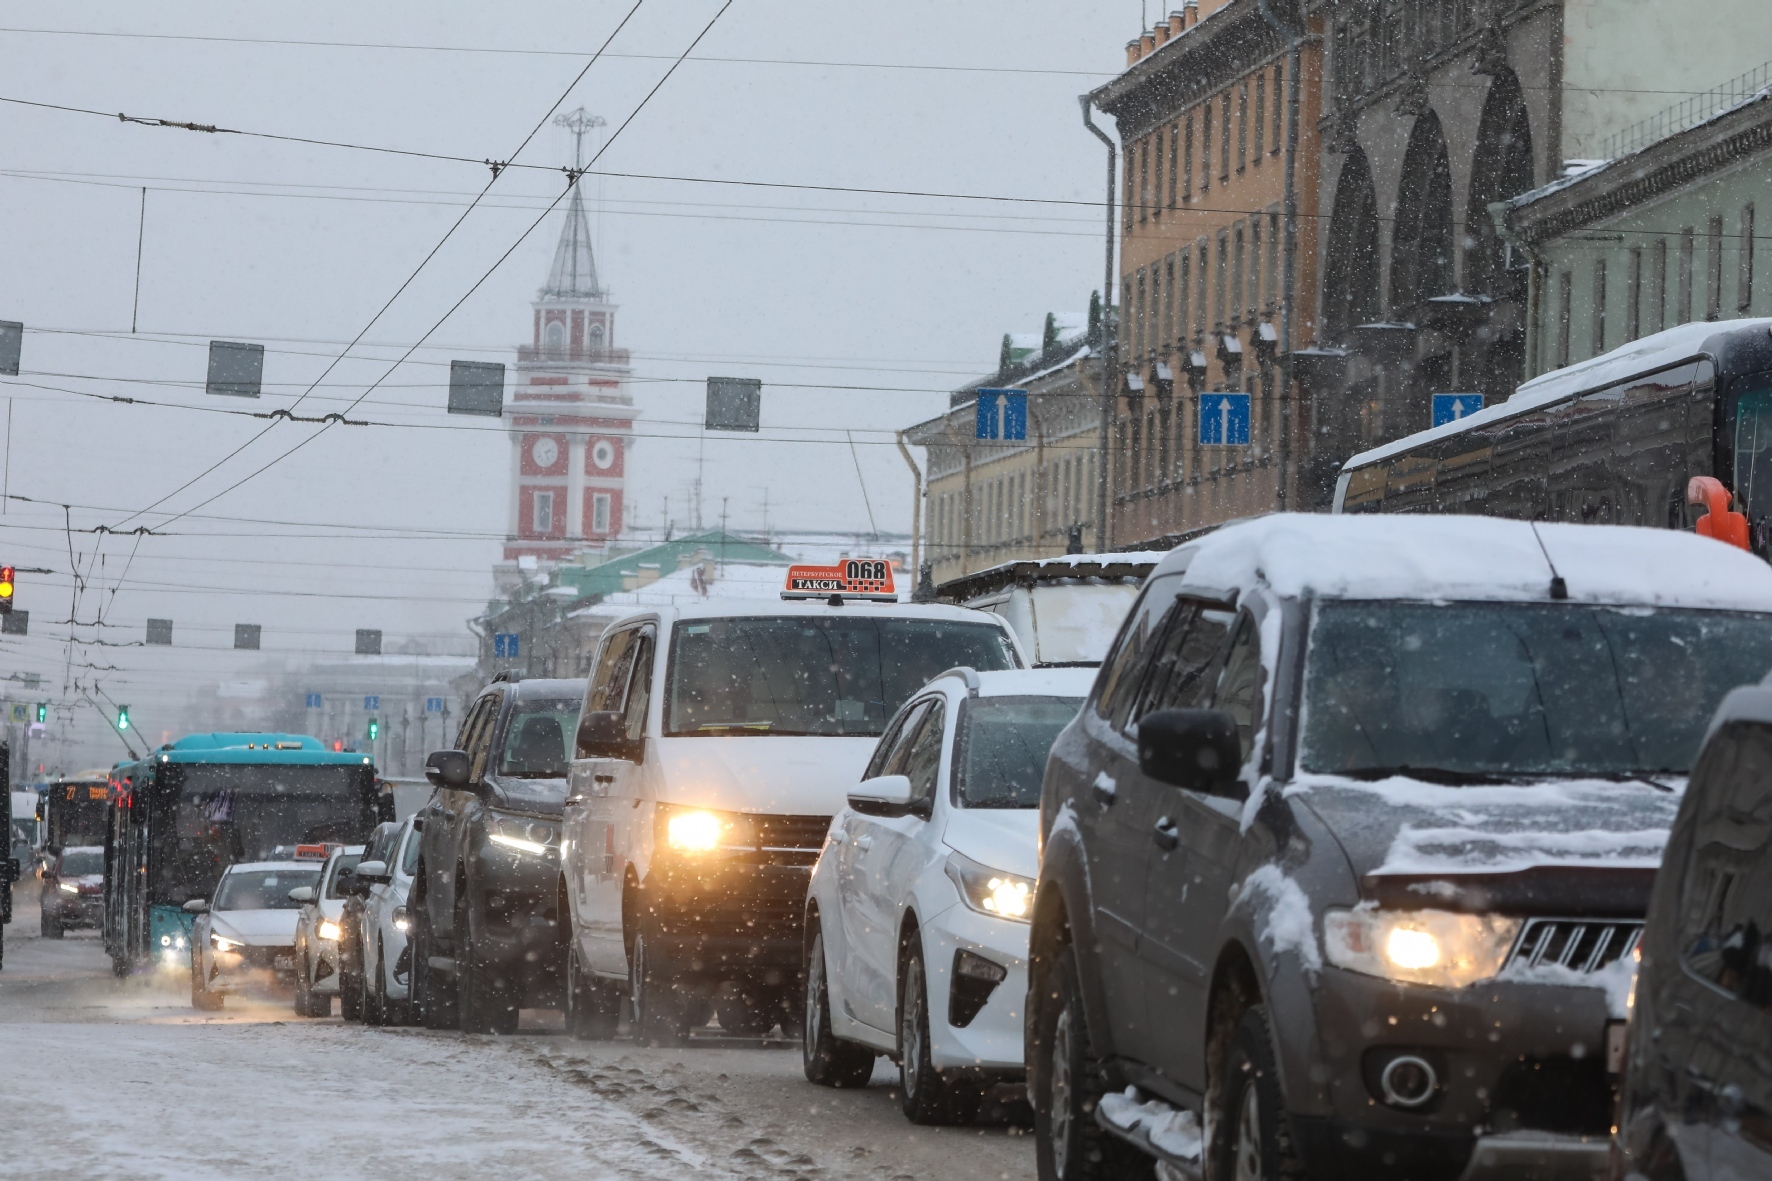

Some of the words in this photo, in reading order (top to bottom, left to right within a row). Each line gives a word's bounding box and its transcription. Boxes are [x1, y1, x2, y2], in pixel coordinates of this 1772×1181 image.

[847, 561, 886, 580] 068
[796, 579, 838, 590] ТАКСИ
[66, 785, 76, 800] 27
